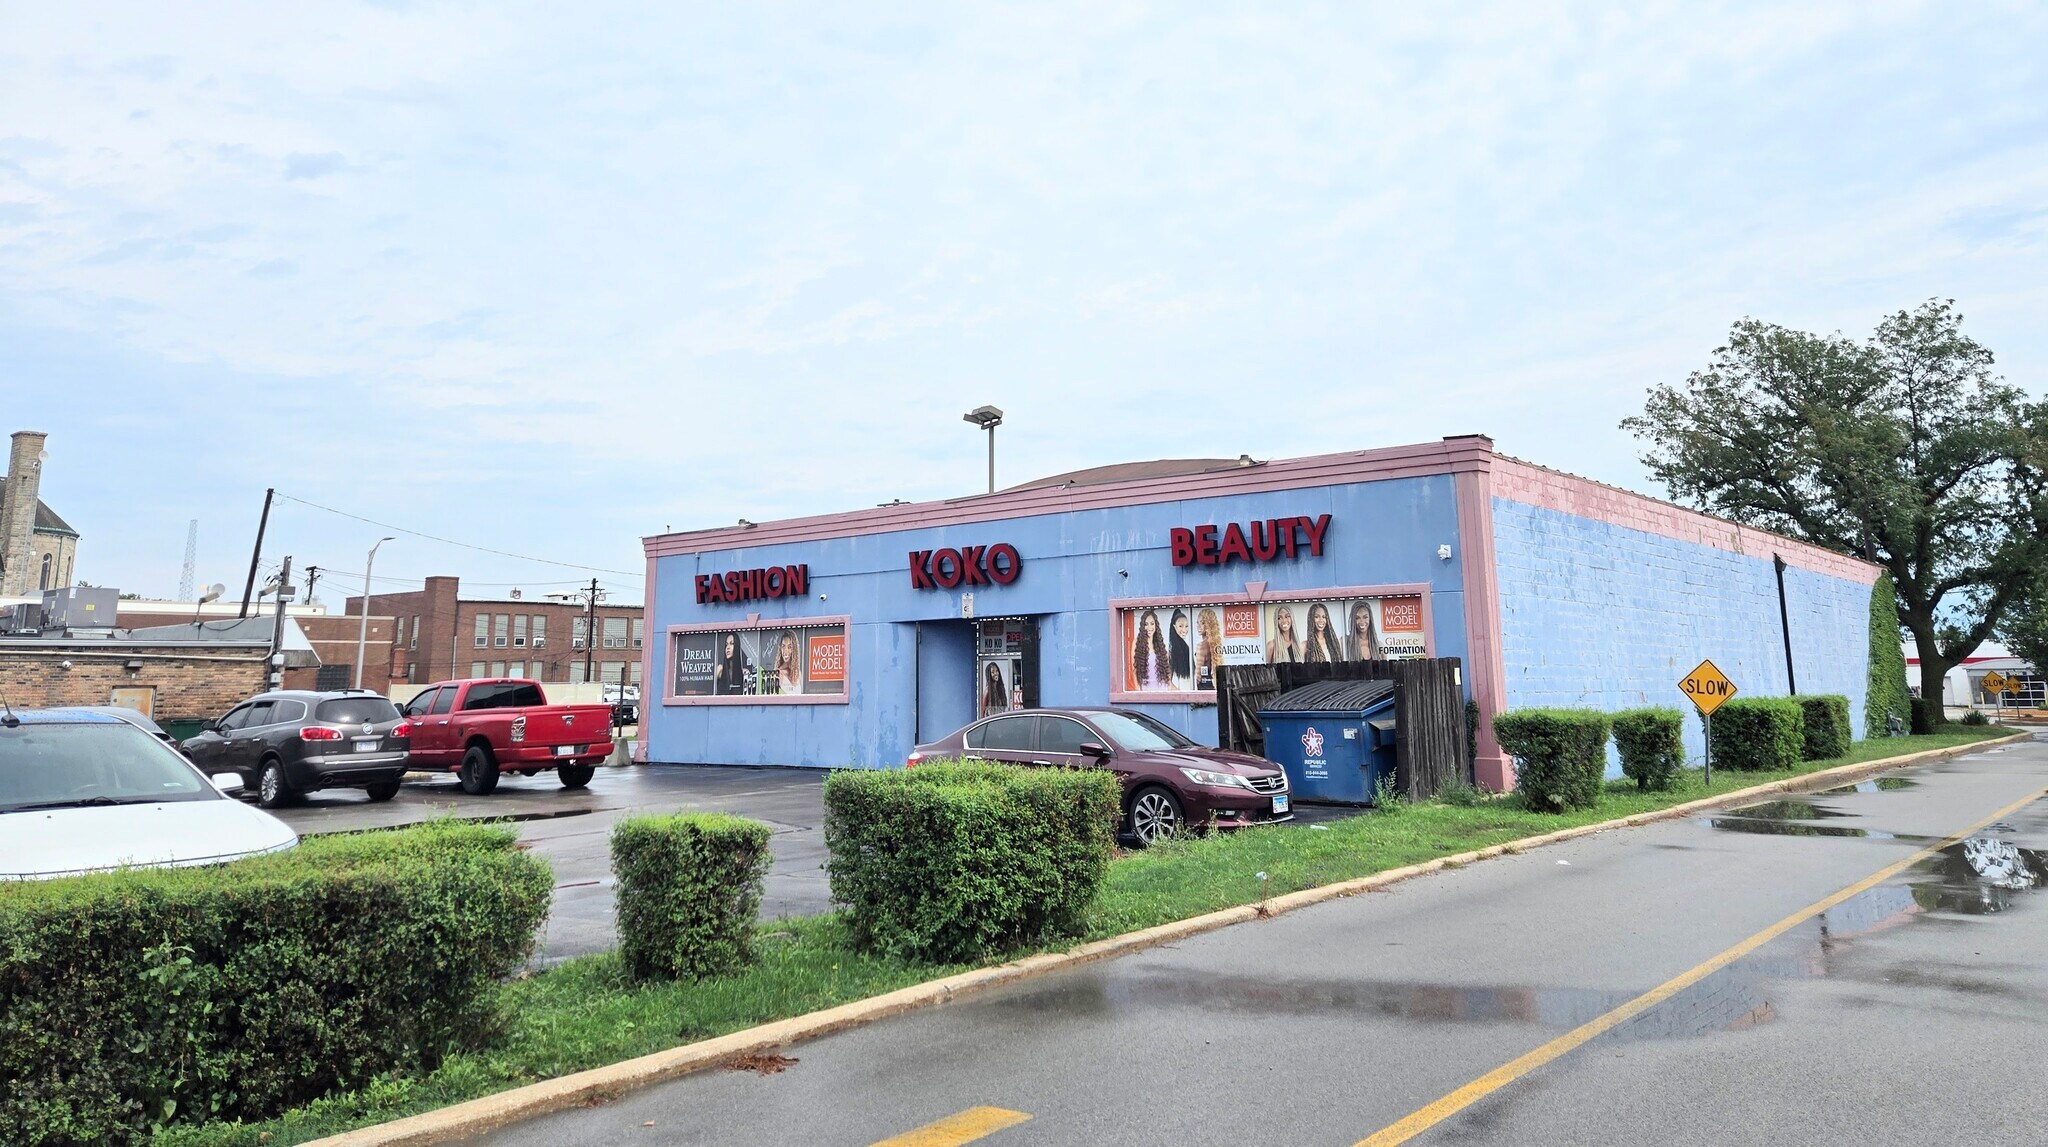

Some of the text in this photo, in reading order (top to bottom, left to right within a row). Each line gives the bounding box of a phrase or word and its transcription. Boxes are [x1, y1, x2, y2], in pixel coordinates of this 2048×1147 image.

[1170, 514, 1332, 566] BEAUTY
[908, 543, 1021, 589] KOKO
[695, 564, 808, 604] FASHION
[1385, 605, 1417, 615] MODEL
[1226, 612, 1254, 621] MODEL
[1385, 615, 1418, 625] MODEL
[1227, 621, 1254, 631] MODEL
[1385, 637, 1418, 646] Glance
[683, 648, 712, 660] DREAM
[812, 644, 843, 657] MODEL
[1214, 645, 1260, 655] GARDENIA
[1379, 646, 1426, 655] FORMATION
[681, 661, 713, 673] WEAVER
[812, 657, 843, 670] MODEL
[1686, 678, 1728, 696] SLOW
[1983, 679, 2004, 687] SLOW
